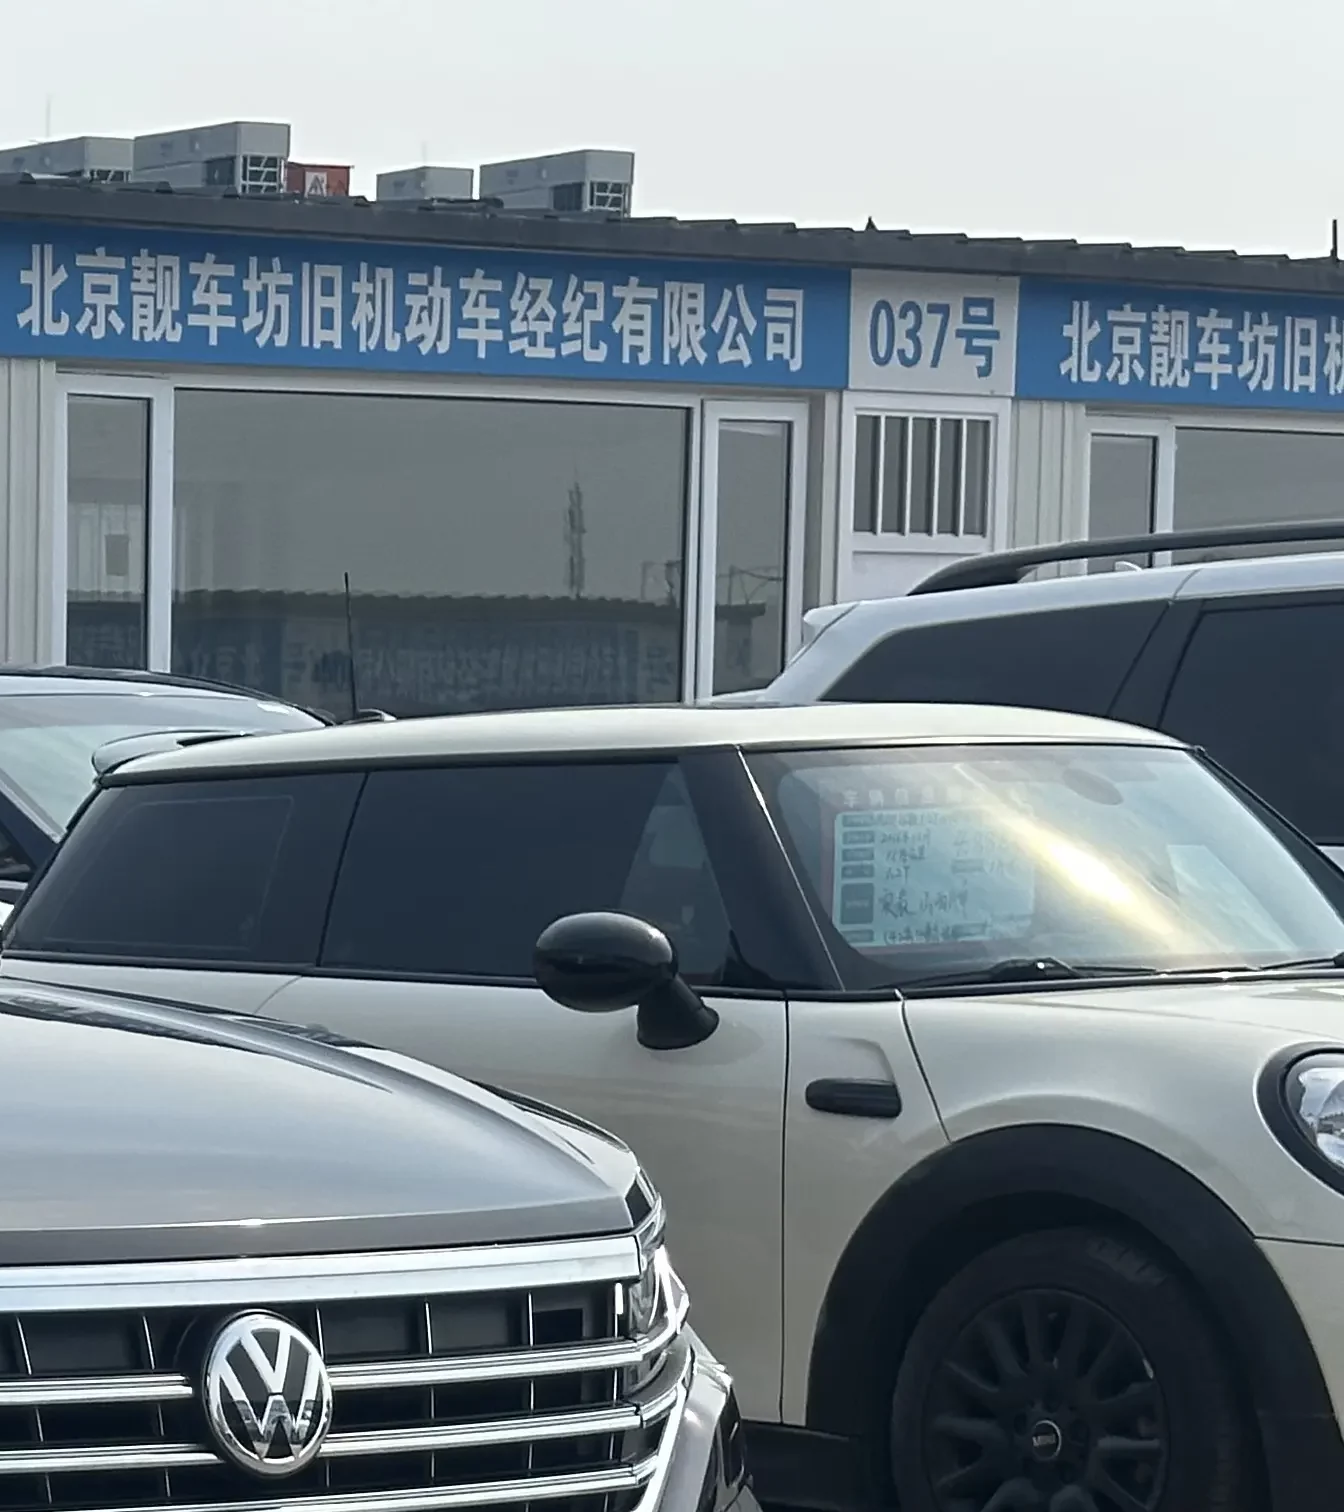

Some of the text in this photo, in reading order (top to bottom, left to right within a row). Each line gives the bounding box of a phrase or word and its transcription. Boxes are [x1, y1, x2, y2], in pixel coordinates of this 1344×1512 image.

[16, 243, 804, 371] 北京靓车坊旧机动车经纪有限公司
[869, 296, 1001, 378] 037号
